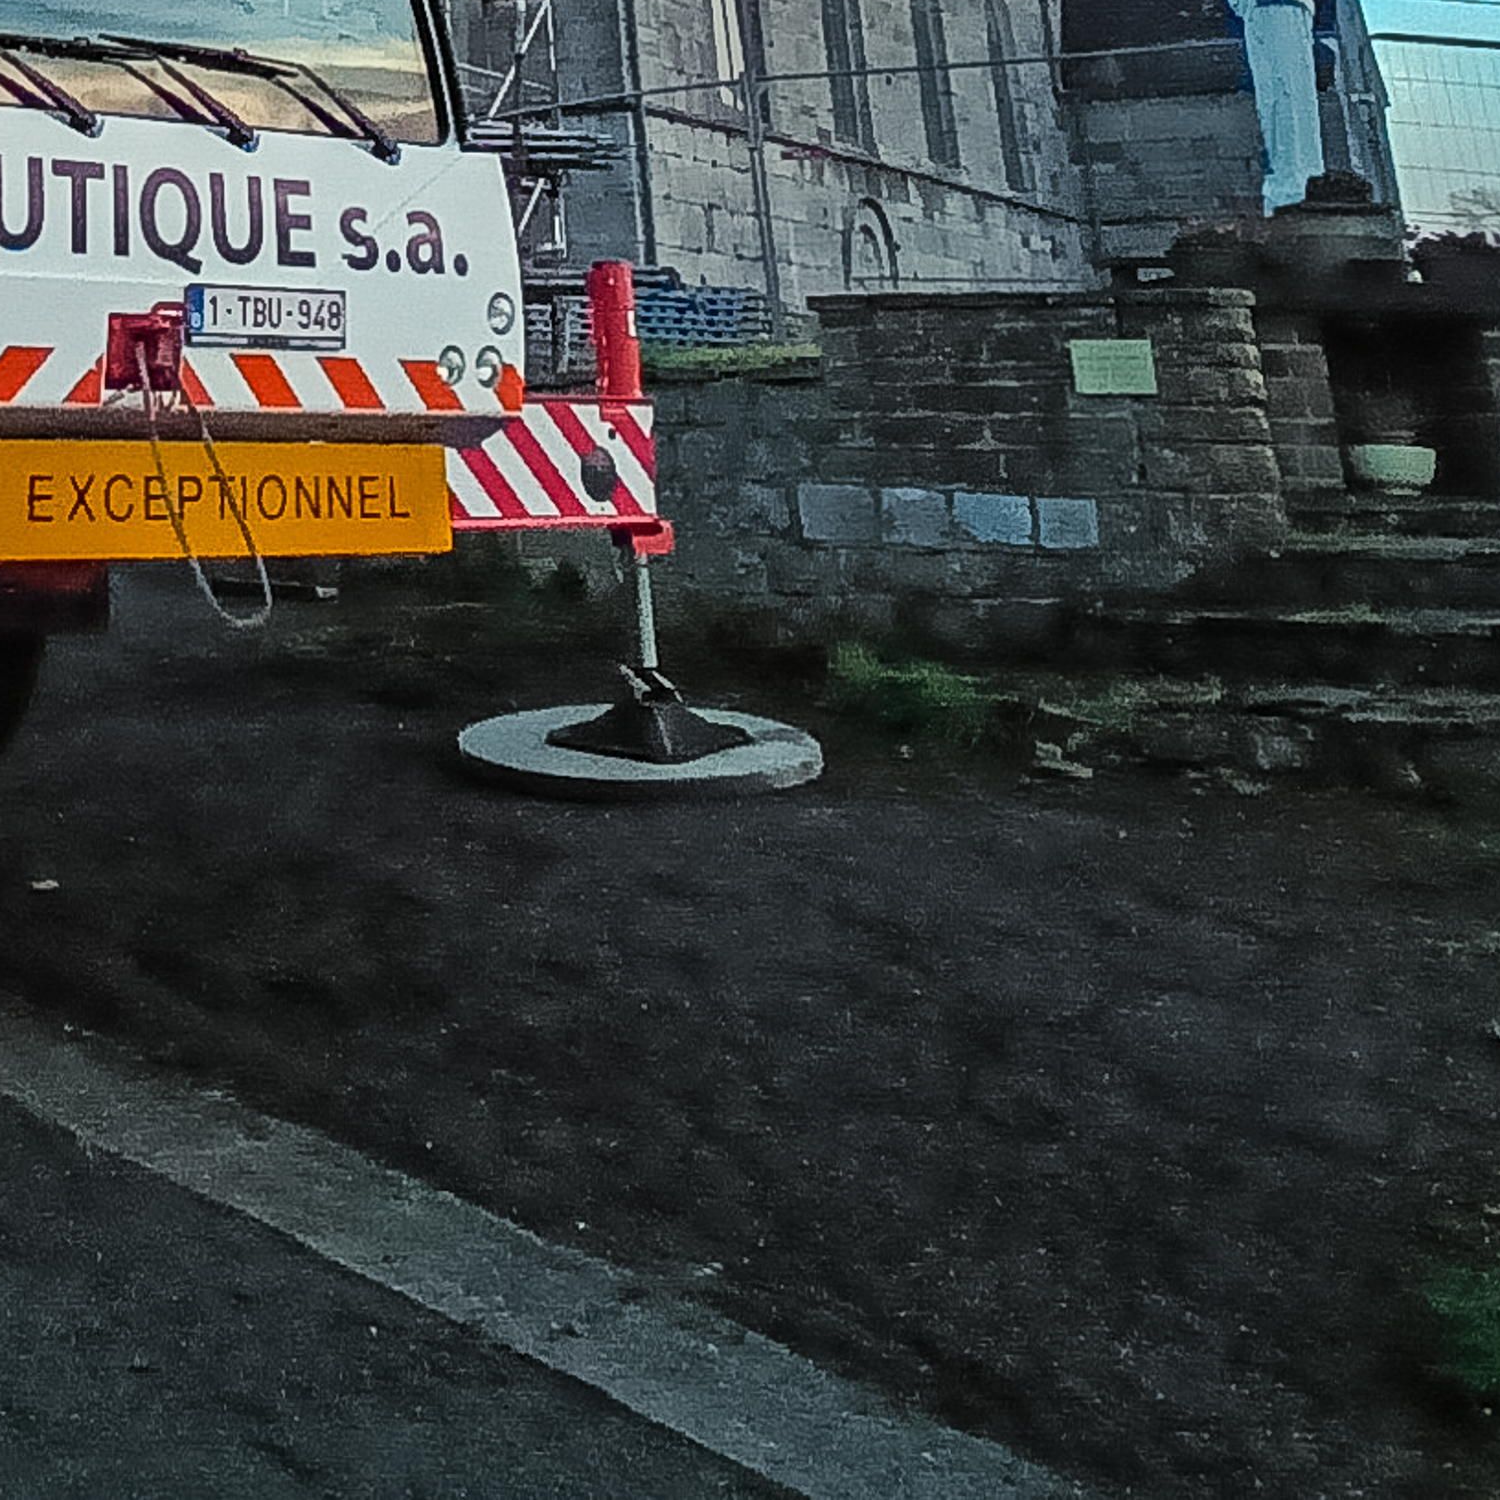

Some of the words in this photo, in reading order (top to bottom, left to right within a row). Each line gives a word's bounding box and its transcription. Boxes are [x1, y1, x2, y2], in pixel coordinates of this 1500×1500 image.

[338, 206, 470, 278] s.a.
[208, 295, 342, 332] 1-TBU-948
[26, 473, 411, 523] EXCEPTIONNEL
